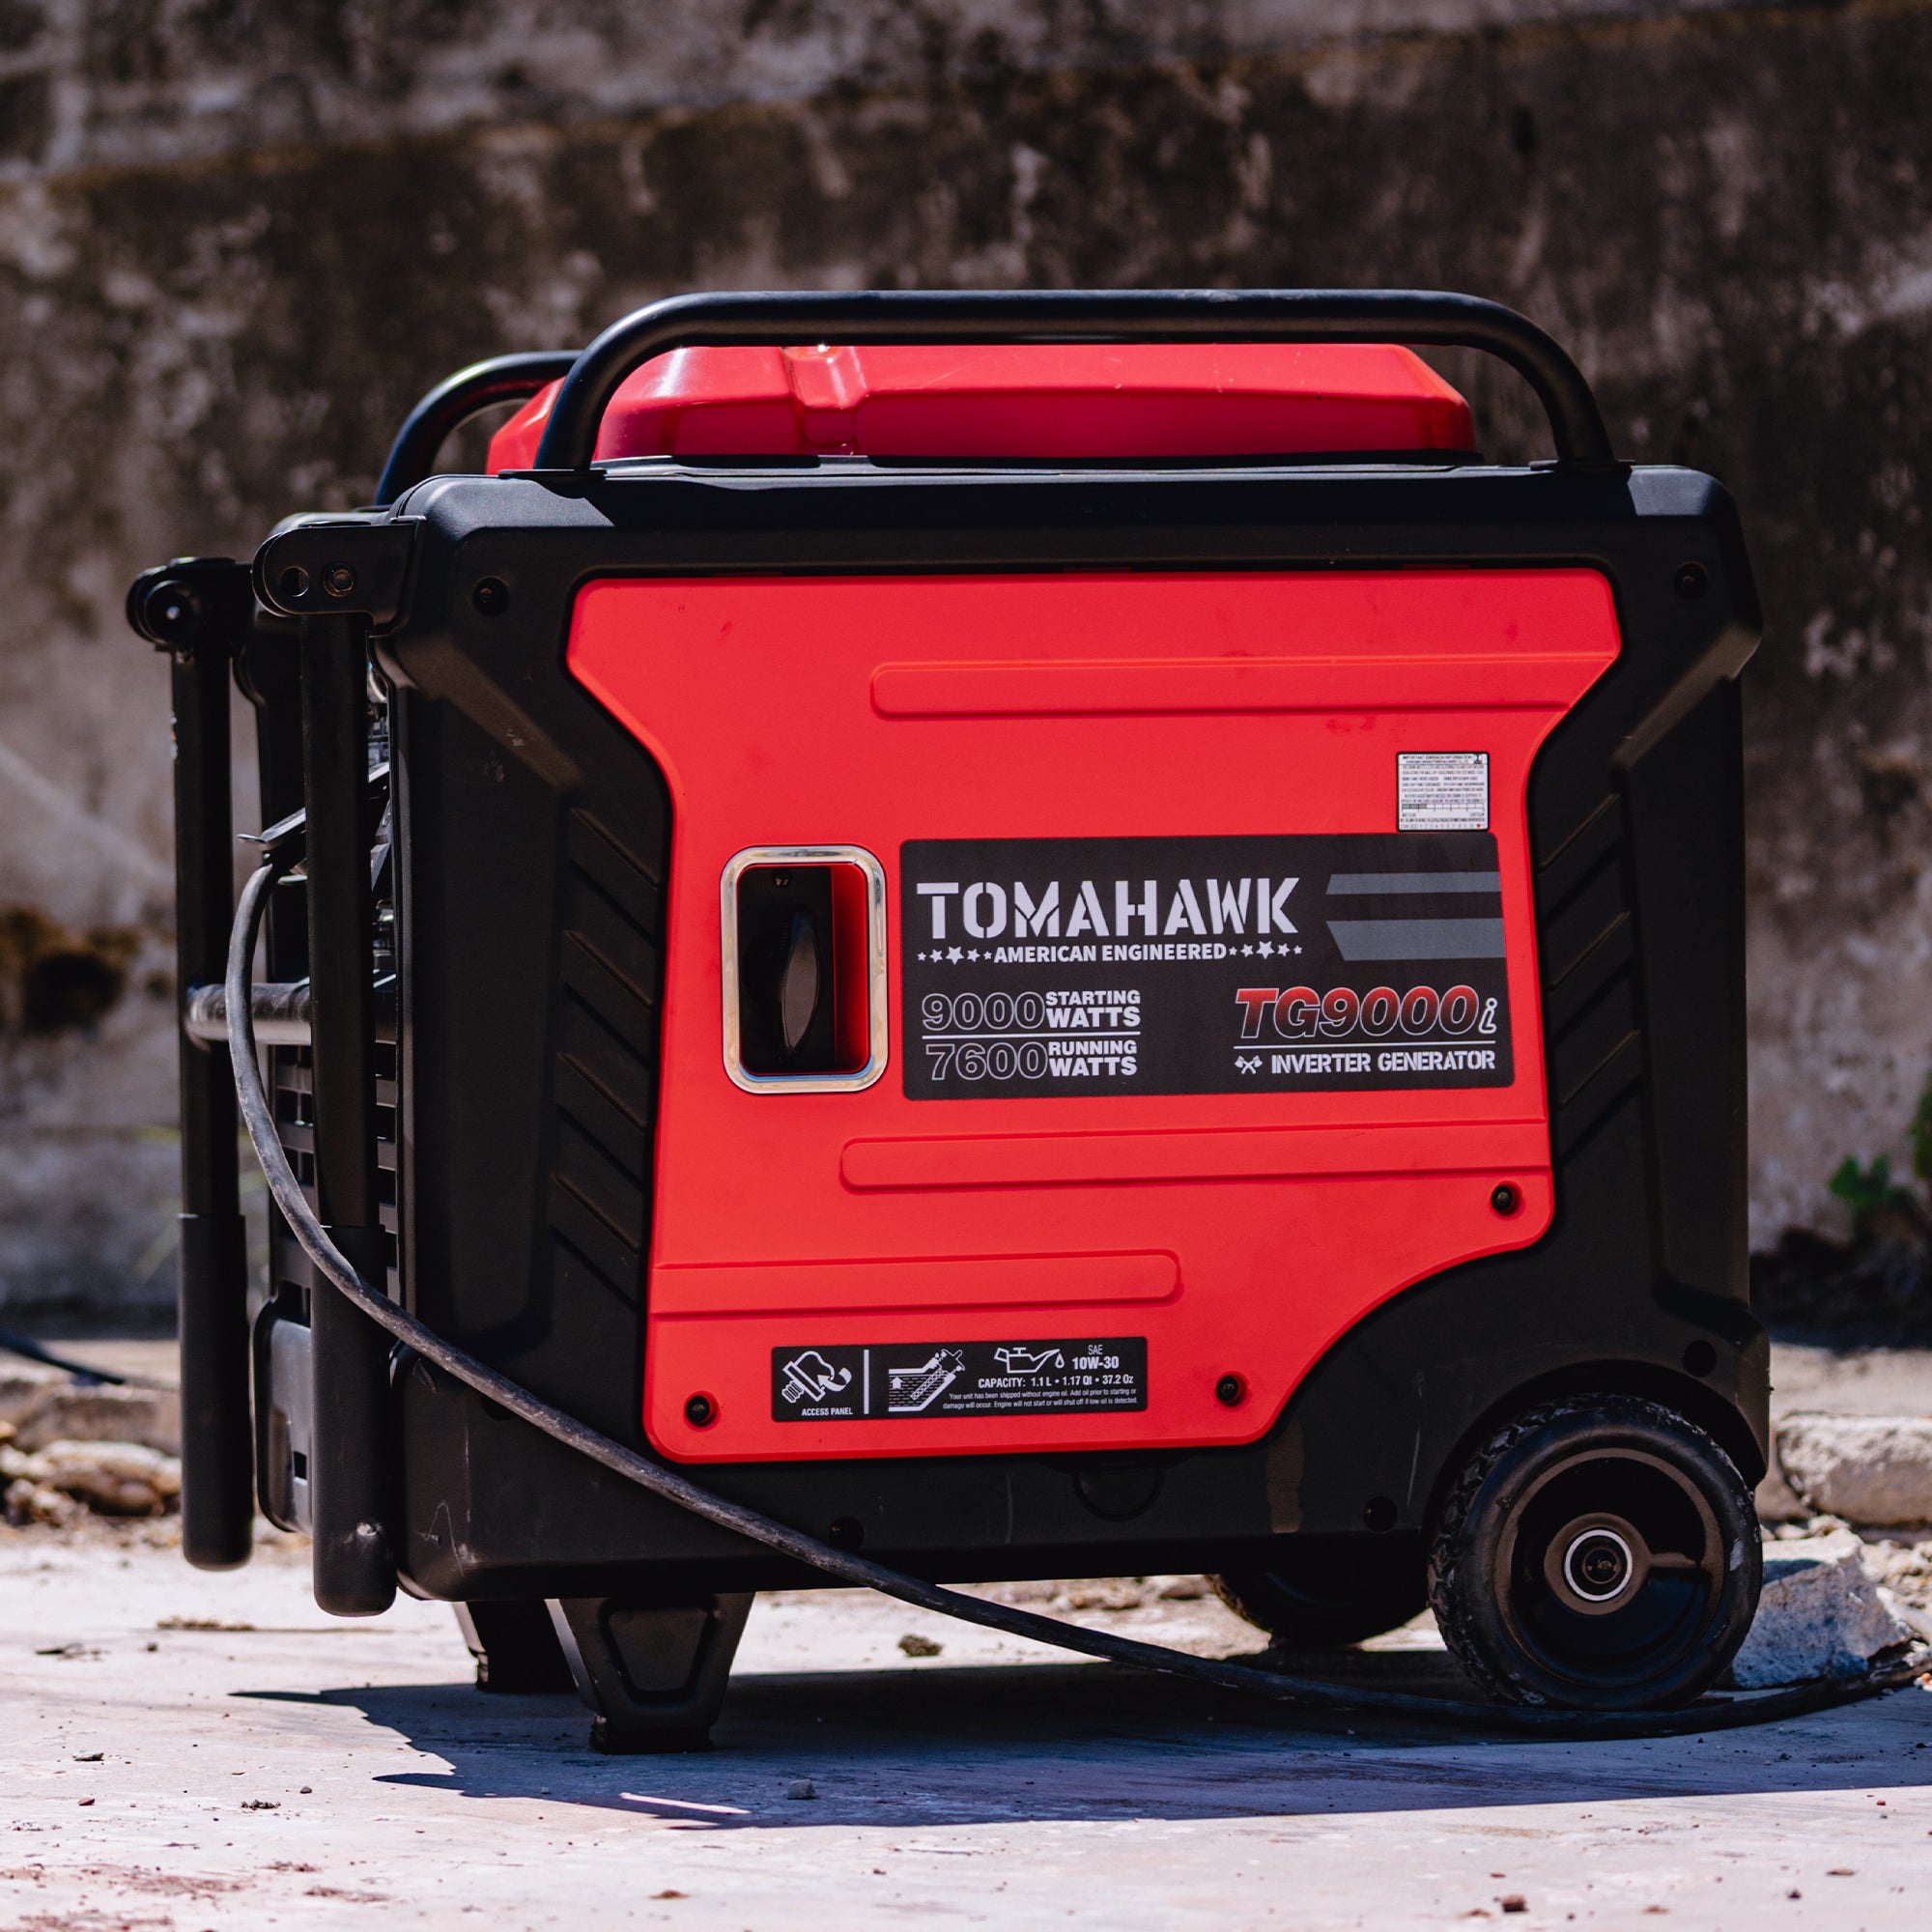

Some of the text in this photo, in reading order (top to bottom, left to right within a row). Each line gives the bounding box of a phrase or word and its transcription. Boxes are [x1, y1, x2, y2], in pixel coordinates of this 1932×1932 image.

[917, 878, 1299, 939] TOMAHAWK
[994, 943, 1227, 964] AMERICAN ENGINEERED
[1045, 990, 1141, 1007] STARTING
[922, 992, 1045, 1031] 9000
[1045, 1008, 1141, 1029] WATTS
[1236, 984, 1497, 1039] TG9000i
[1048, 1040, 1137, 1056] RUNNING
[926, 1041, 1048, 1081] 7600
[1049, 1056, 1137, 1078] WATTS
[1271, 1050, 1496, 1074] INVERTER GENERATOR
[1088, 1345, 1103, 1355] SAE
[1072, 1355, 1120, 1370] 10W-30
[979, 1374, 1134, 1388] CAPACITY: 1.1 L 1.17 Qt 37.2 Oz
[994, 1401, 1012, 1409] Engine
[1000, 1391, 1021, 1400] shipped
